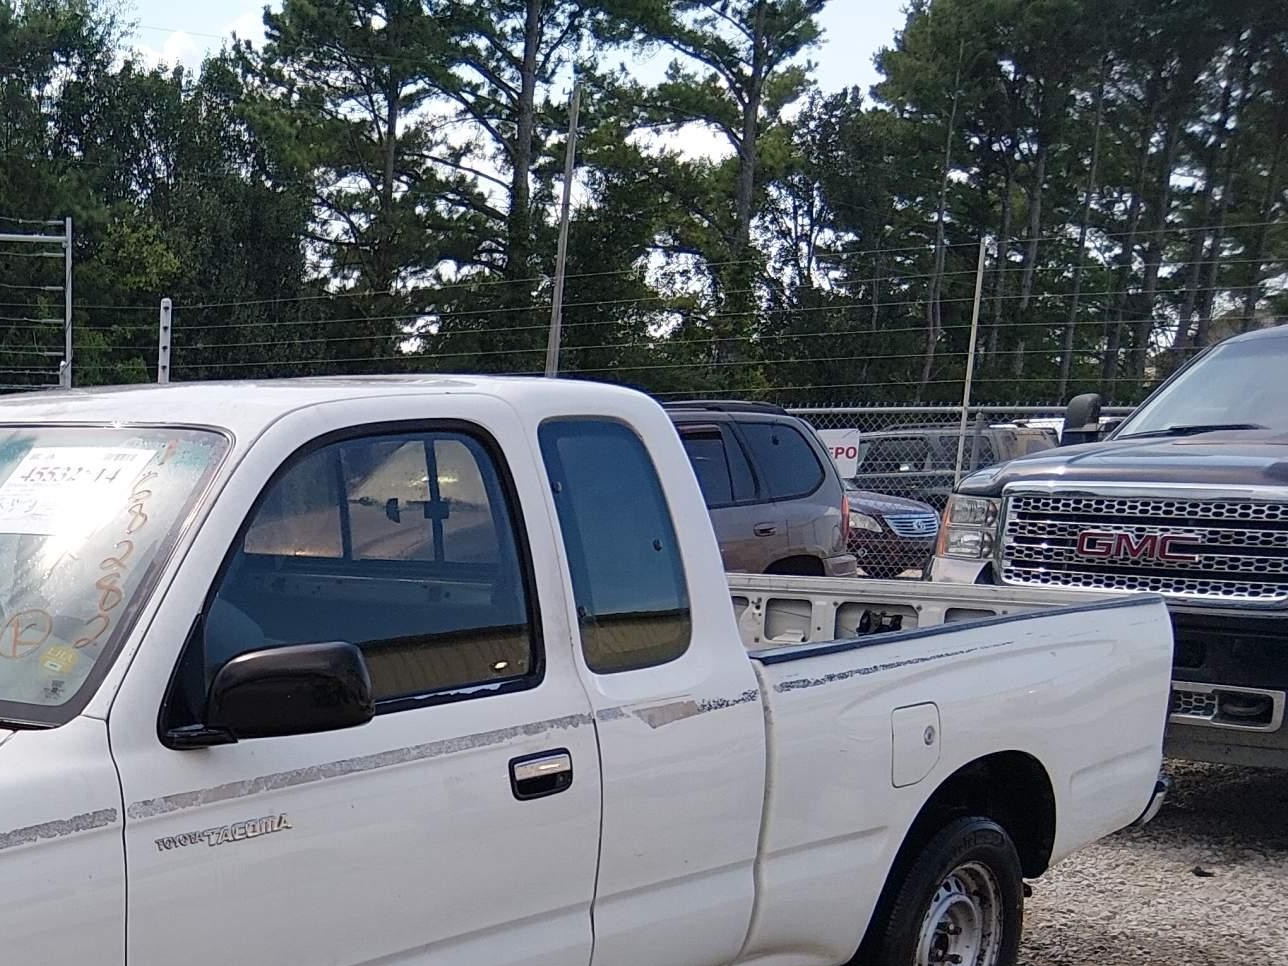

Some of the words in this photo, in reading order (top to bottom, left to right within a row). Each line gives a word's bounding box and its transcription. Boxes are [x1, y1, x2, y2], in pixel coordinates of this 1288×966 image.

[1076, 529, 1202, 562] GMC
[154, 831, 205, 852] TOYOTA
[205, 813, 294, 847] TACOMA
